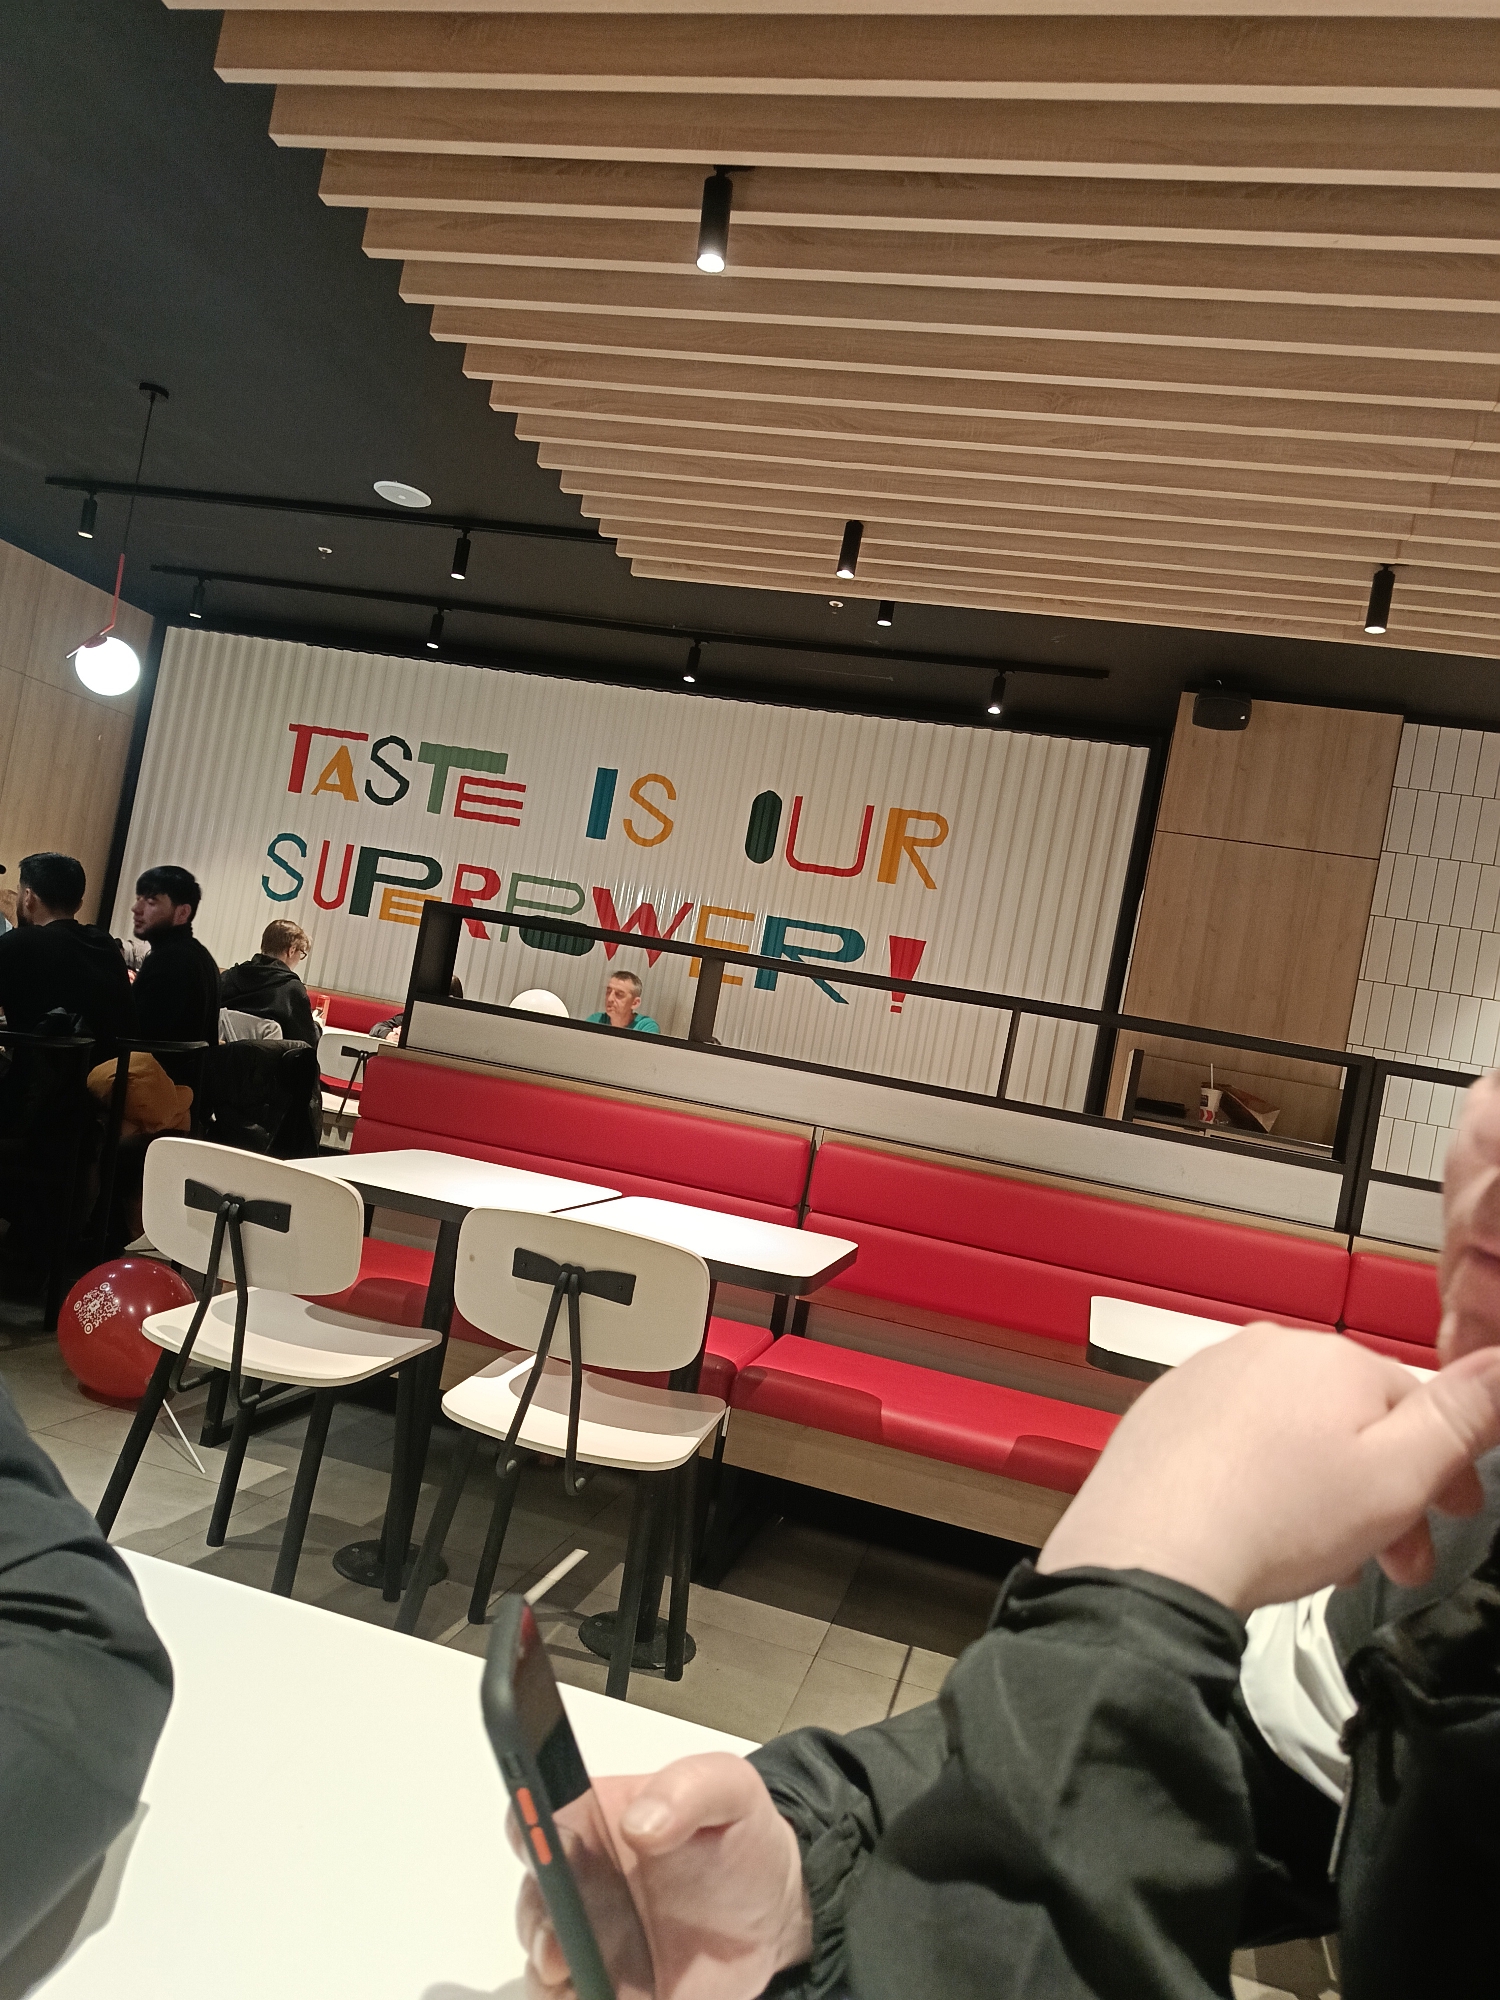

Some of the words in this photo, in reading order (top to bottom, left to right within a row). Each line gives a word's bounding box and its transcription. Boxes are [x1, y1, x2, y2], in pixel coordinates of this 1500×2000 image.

[287, 723, 527, 827] TASTE
[585, 766, 677, 848] IS
[744, 789, 949, 890] OUR
